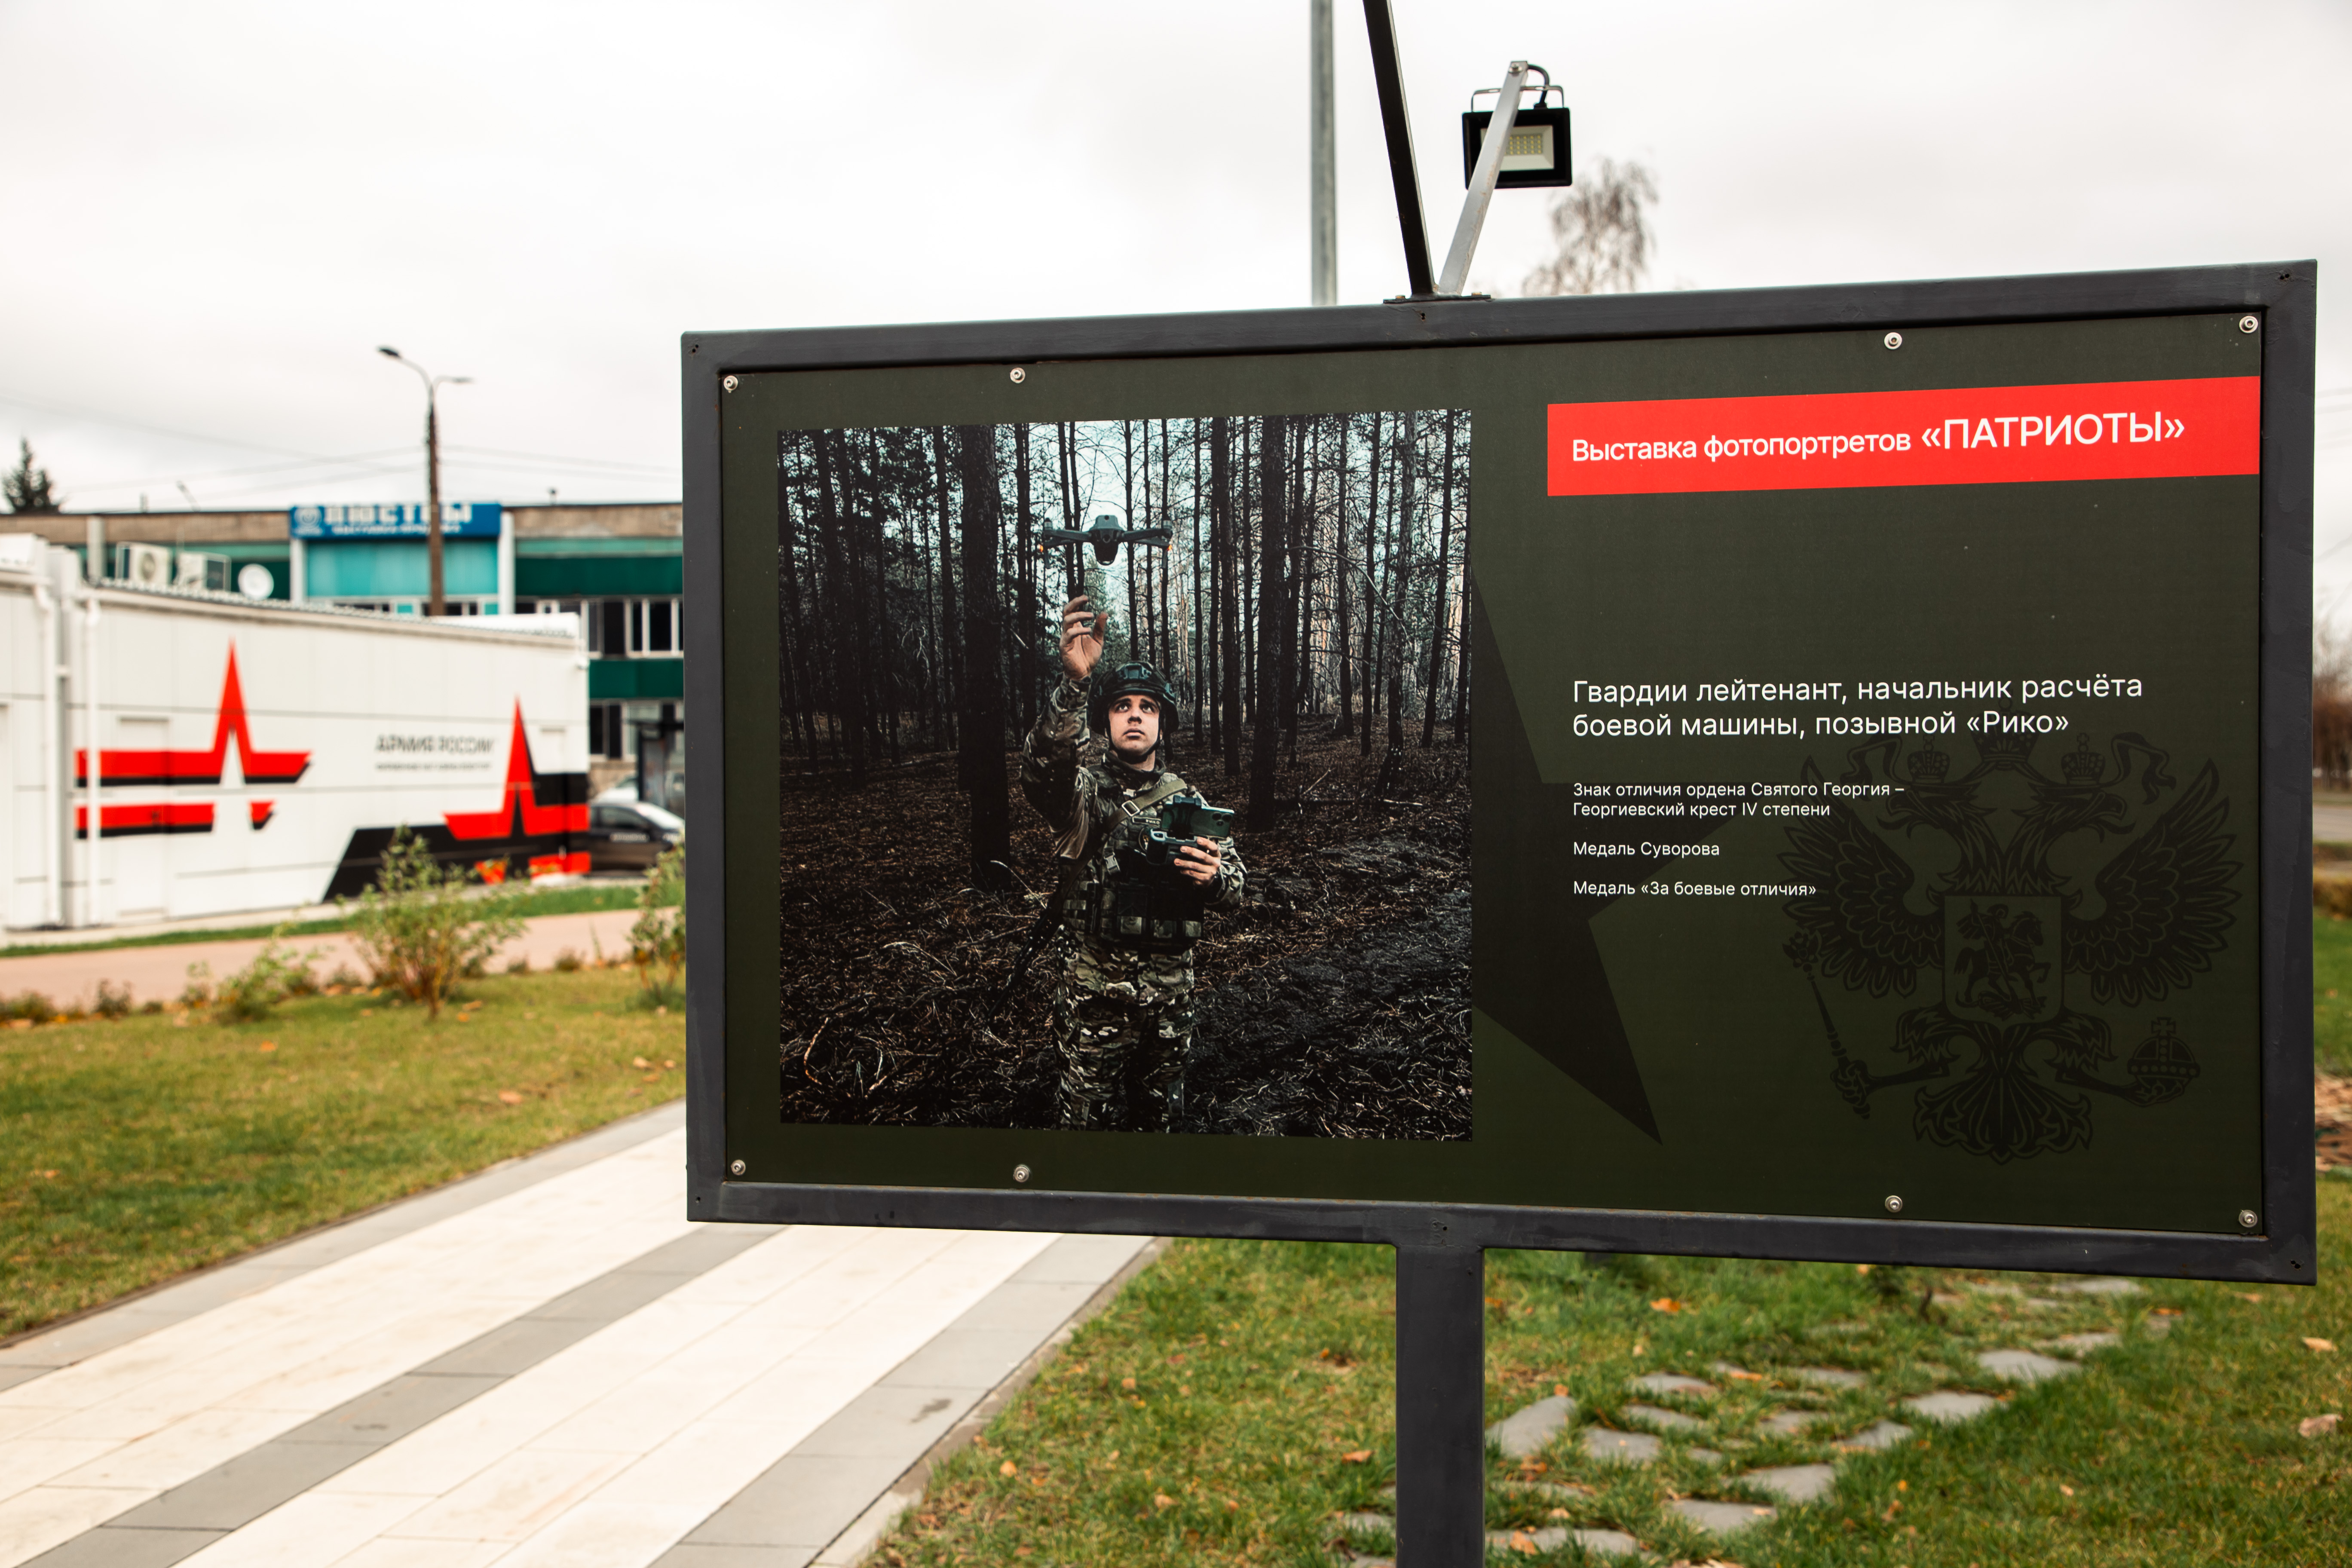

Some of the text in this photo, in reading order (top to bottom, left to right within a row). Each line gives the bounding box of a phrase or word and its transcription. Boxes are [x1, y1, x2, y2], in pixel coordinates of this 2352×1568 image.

[1572, 410, 2185, 463] Выставка фотопортретов «ПАТРИОТЫ»
[1574, 673, 2142, 708] Гвардии лейтенант, начальник расчёта
[1573, 710, 2069, 740] боевой машины, позывной «Рико»
[1573, 782, 1611, 796] Знак
[1616, 785, 1681, 796] отличия
[1686, 785, 1746, 799] ордена
[1751, 782, 1818, 796] Святого
[1823, 781, 1890, 799] Георгия
[1573, 802, 1830, 819] Георгиевский крест IV степени
[1574, 841, 1720, 859] Медаль Суворова
[1574, 880, 1816, 897] Медаль «За боевые отличия»
